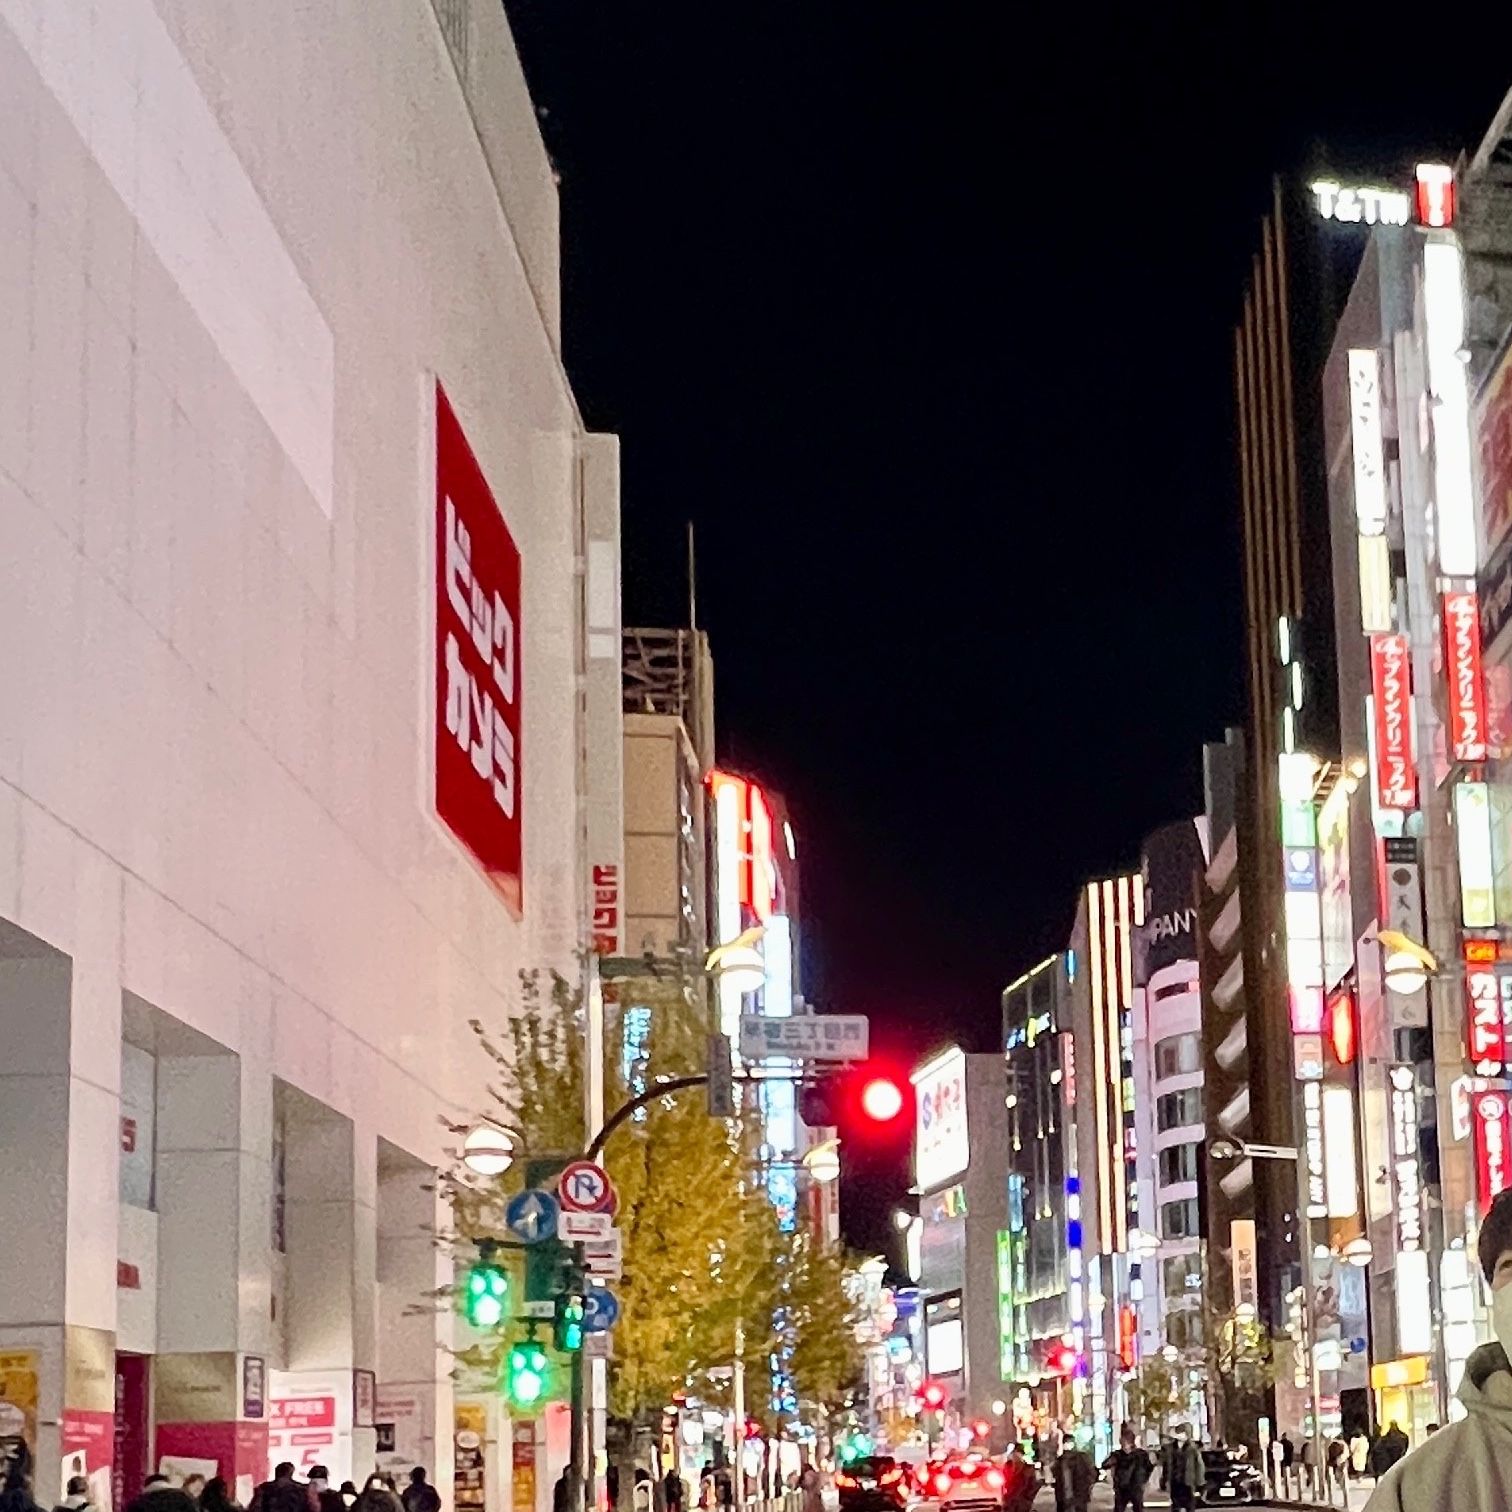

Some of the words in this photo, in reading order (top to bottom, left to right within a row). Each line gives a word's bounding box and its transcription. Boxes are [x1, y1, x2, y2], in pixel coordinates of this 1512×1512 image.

[446, 494, 514, 705] ビック
[446, 631, 514, 820] カメラ
